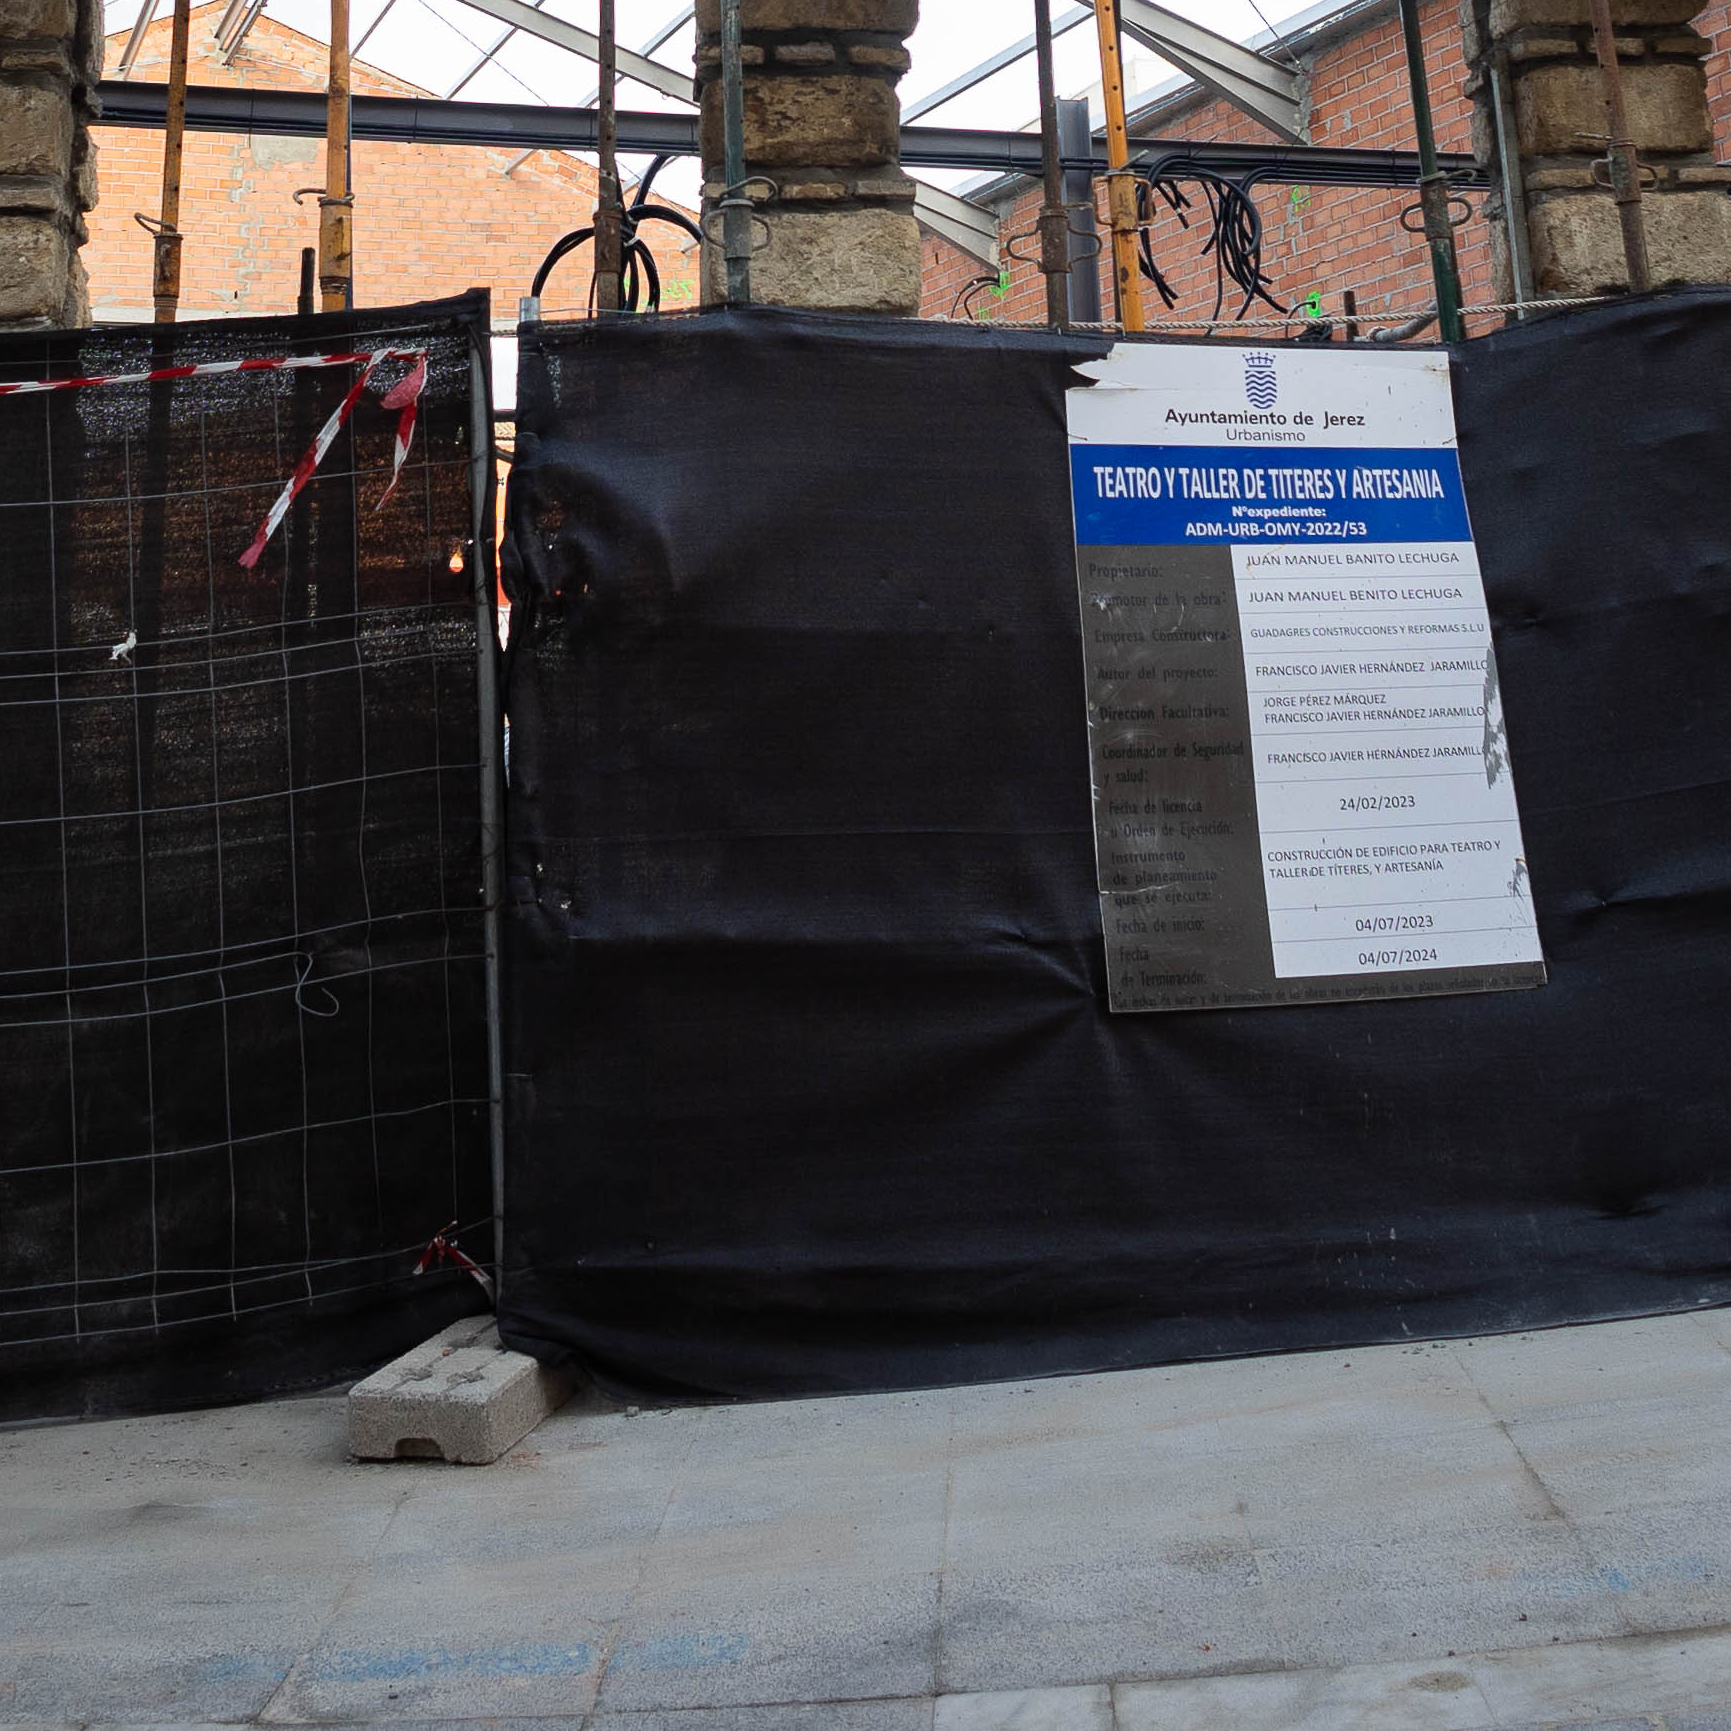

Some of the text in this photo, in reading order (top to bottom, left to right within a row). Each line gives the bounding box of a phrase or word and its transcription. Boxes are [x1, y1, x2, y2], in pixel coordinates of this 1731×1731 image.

[1165, 409, 1366, 428] Ayuntamiento de Jerez
[1226, 428, 1306, 442] Urbanismo
[1093, 466, 1445, 500] TEATRO Y TALLER DE TITERES Y ARTESANIA
[1185, 520, 1367, 537] ADM-URB-OMY-2022/53
[1247, 552, 1460, 566] JUAN MANUEL BANITO LECHUGA
[1155, 590, 1169, 605] de
[1193, 589, 1227, 605] obra:
[1249, 588, 1463, 603] JUAN MANUEL BENITO LECHUGA
[1094, 629, 1145, 646] Empresa
[1250, 627, 1311, 638] GUADAGRES
[1312, 625, 1398, 637] CONSTRUCCIONES
[1400, 625, 1407, 635] Y
[1408, 624, 1460, 634] REFORMAS
[1097, 666, 1219, 682] Autor del proyecto:
[1256, 665, 1317, 676] FRANCISCO
[1320, 663, 1357, 675] JAVIER
[1359, 660, 1425, 674] HERNÁNDEZ
[1263, 692, 1387, 707] JORGE PÉREZ MÁRQUEZ
[1264, 707, 1486, 724] FRANCISCO JAVIER HERNÁNDEZ JARAMILLO
[1102, 740, 1244, 761] Coordinador de Seguridad
[1267, 752, 1327, 764] FRANCISCO
[1329, 750, 1365, 762] JAVIER
[1367, 746, 1430, 759] HERNÁNDEZ
[1103, 769, 1149, 788] y salud:
[1109, 800, 1138, 815] Fecha
[1144, 799, 1157, 814] de
[1339, 795, 1416, 811] 24/02/2023
[1123, 823, 1156, 837] Orden
[1162, 822, 1175, 836] de
[1111, 851, 1186, 864] Instrumento
[1268, 840, 1501, 862] CONSTRUCCIÓN DE EDIFICIO PARA TEATRO Y
[1113, 868, 1217, 885] de planeamiento
[1270, 859, 1444, 879] TALLER DE TÍTERES, Y ARTESANÍA
[1115, 891, 1212, 909] que se ejecuta:
[1117, 916, 1205, 933] Fecha de inicio:
[1355, 915, 1434, 932] 04/07/2023
[1358, 948, 1438, 966] 04/07/2024
[1121, 971, 1134, 988] de
